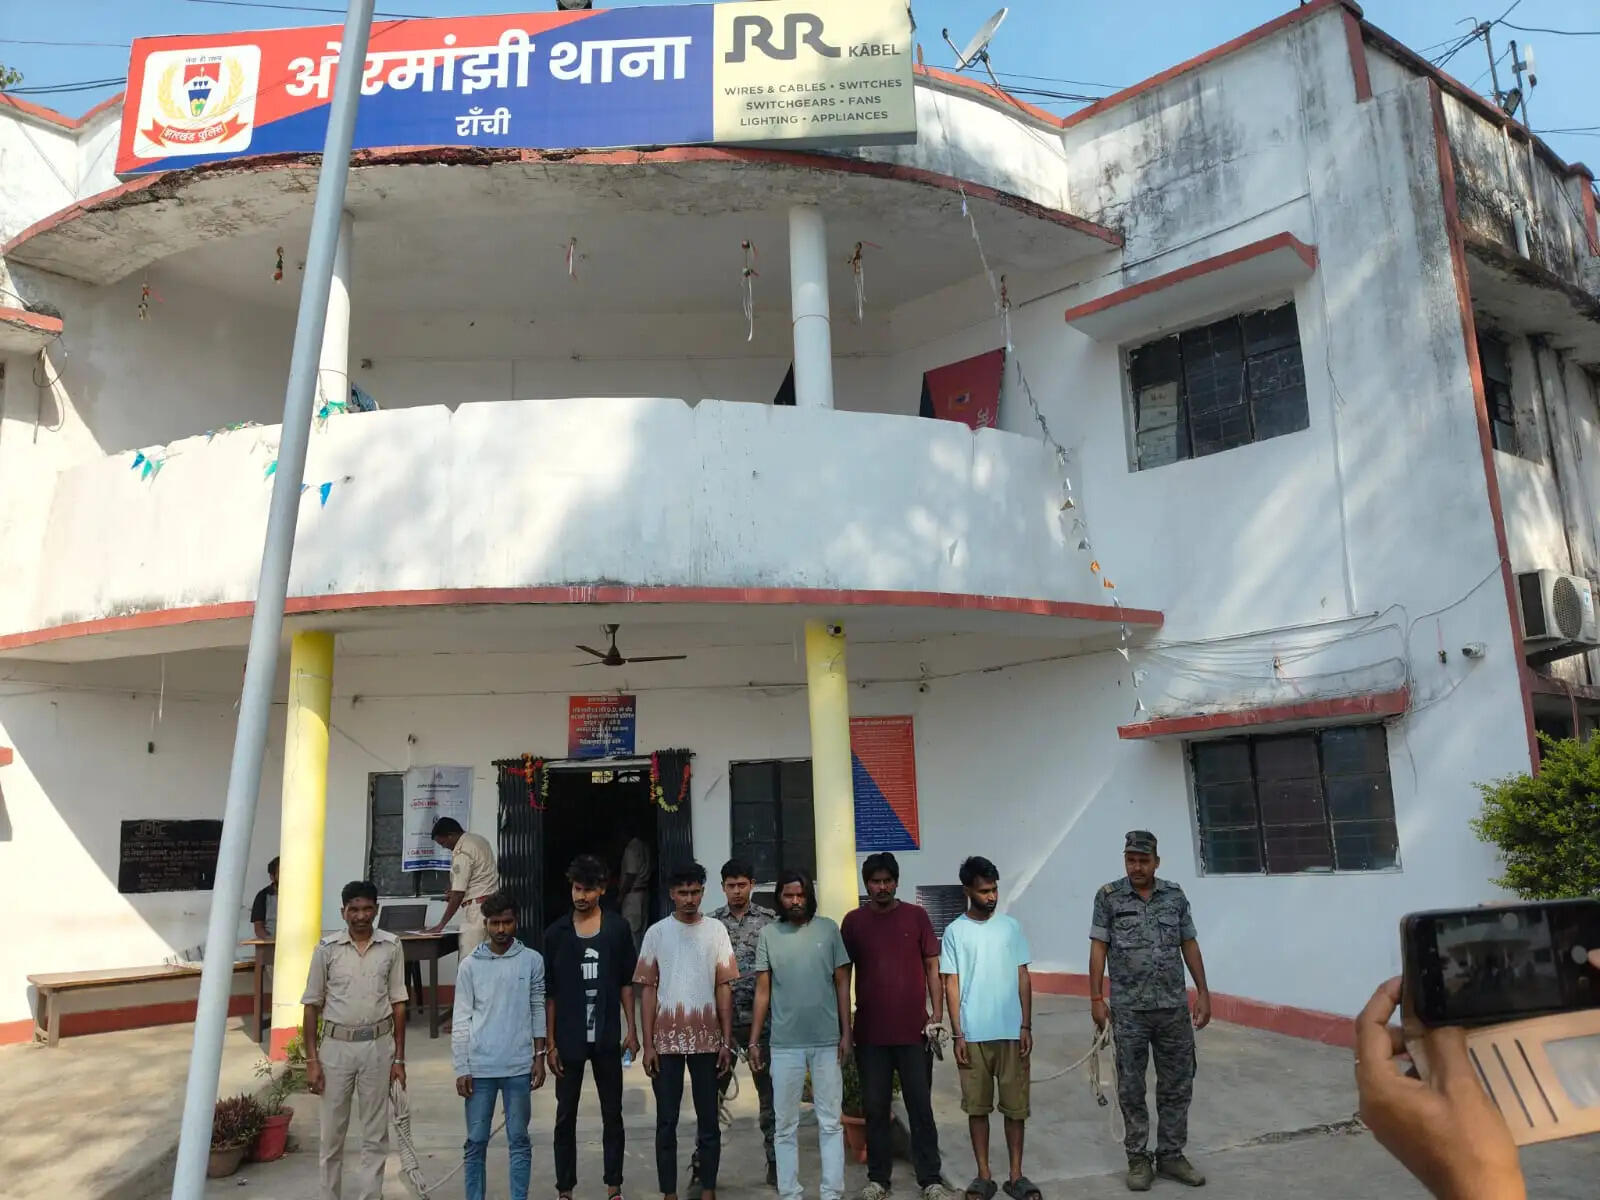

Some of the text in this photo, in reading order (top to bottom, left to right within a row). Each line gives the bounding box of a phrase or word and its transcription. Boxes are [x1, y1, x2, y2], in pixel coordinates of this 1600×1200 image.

[725, 13, 841, 63] RR
[549, 36, 692, 84] थाना
[724, 79, 902, 96] WIRES & CABLES SWITCHES
[746, 95, 882, 110] SWITCHGEARS FANS
[455, 106, 512, 137] राँची
[740, 111, 889, 126] LIGHTING APPLIANCES
